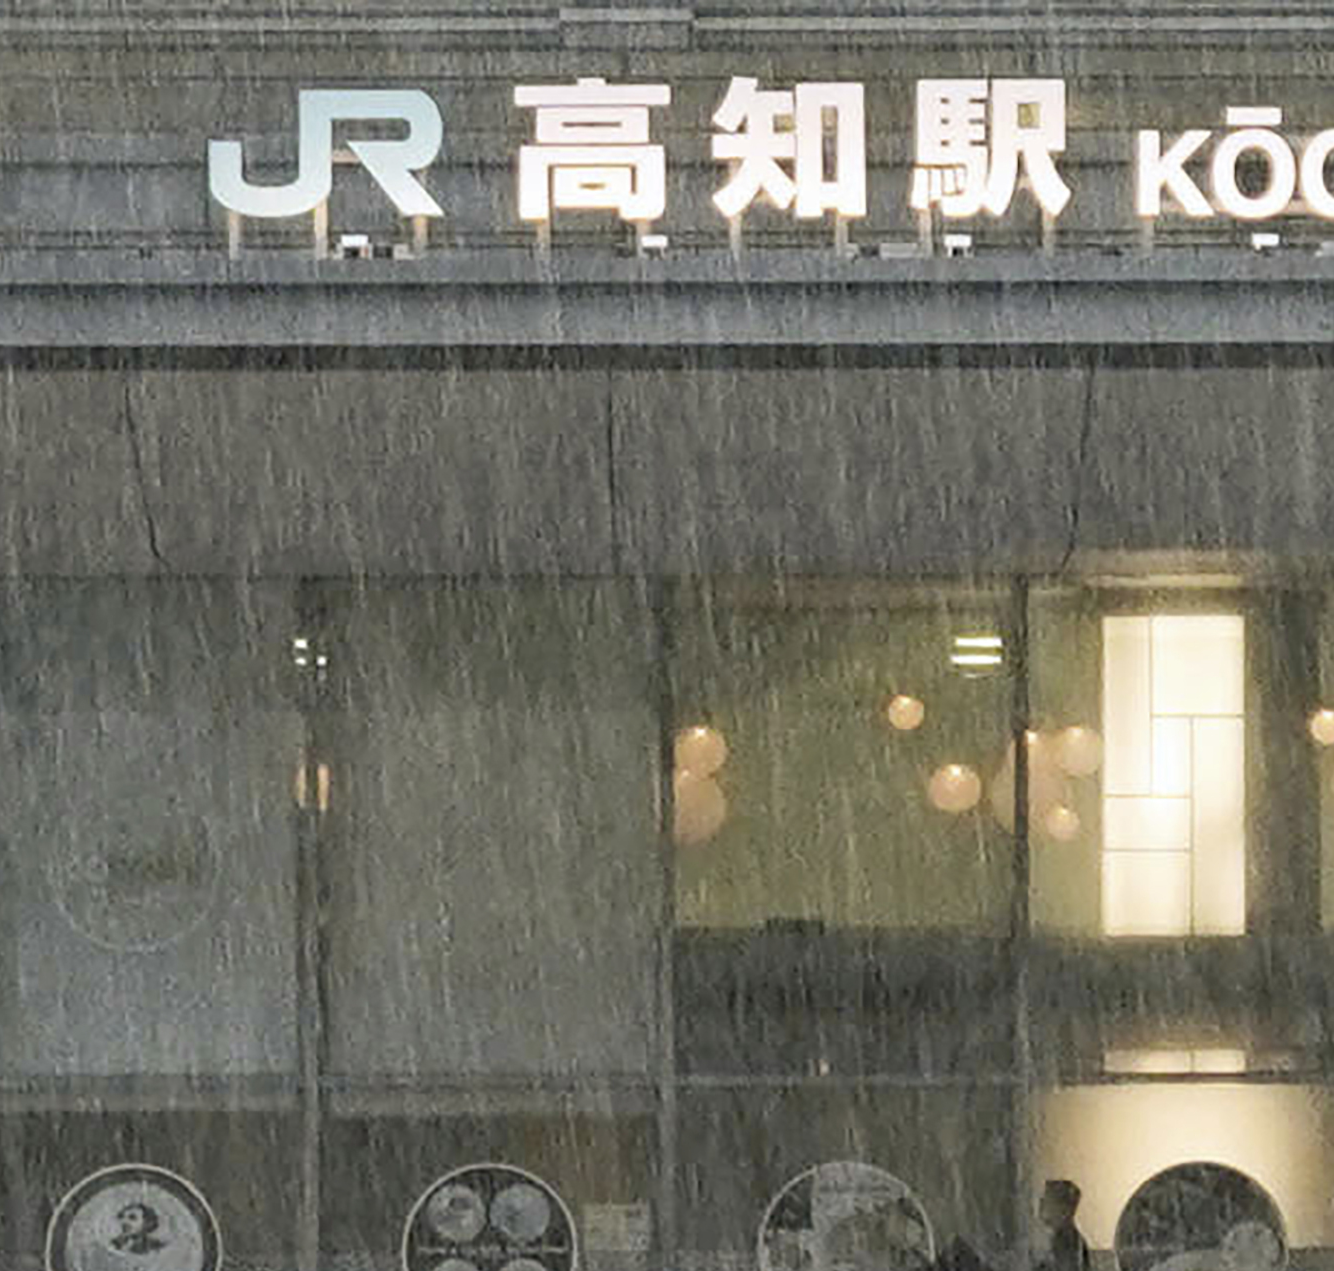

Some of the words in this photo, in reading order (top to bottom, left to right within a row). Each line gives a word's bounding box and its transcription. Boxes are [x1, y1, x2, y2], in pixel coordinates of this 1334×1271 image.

[208, 89, 444, 217] JR
[513, 77, 1071, 219] 高知駅
